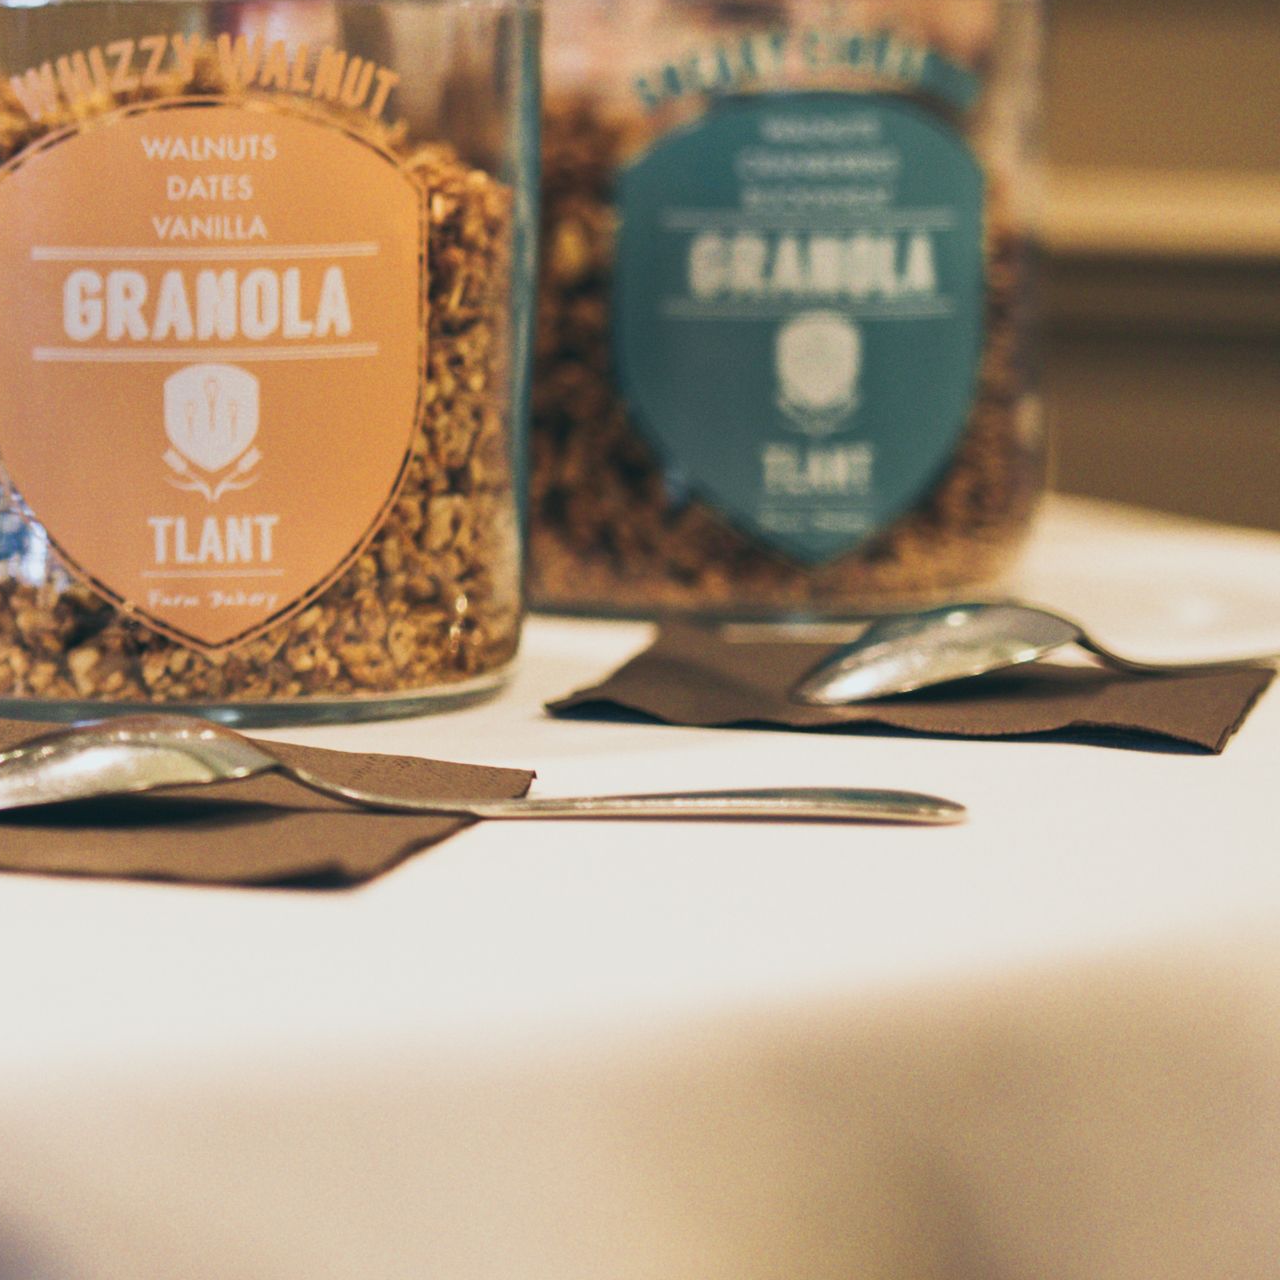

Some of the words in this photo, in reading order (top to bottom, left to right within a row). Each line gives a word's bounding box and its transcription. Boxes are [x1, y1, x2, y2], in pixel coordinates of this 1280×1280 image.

[9, 33, 206, 121] WHIZZY
[216, 33, 401, 120] WALNUT
[140, 135, 278, 162] WALNUTS
[166, 174, 254, 202] DATES
[151, 214, 269, 241] VANILLA
[687, 230, 937, 302] GRANOLA
[62, 266, 352, 342] GRANOLA
[147, 514, 280, 565] TLANT
